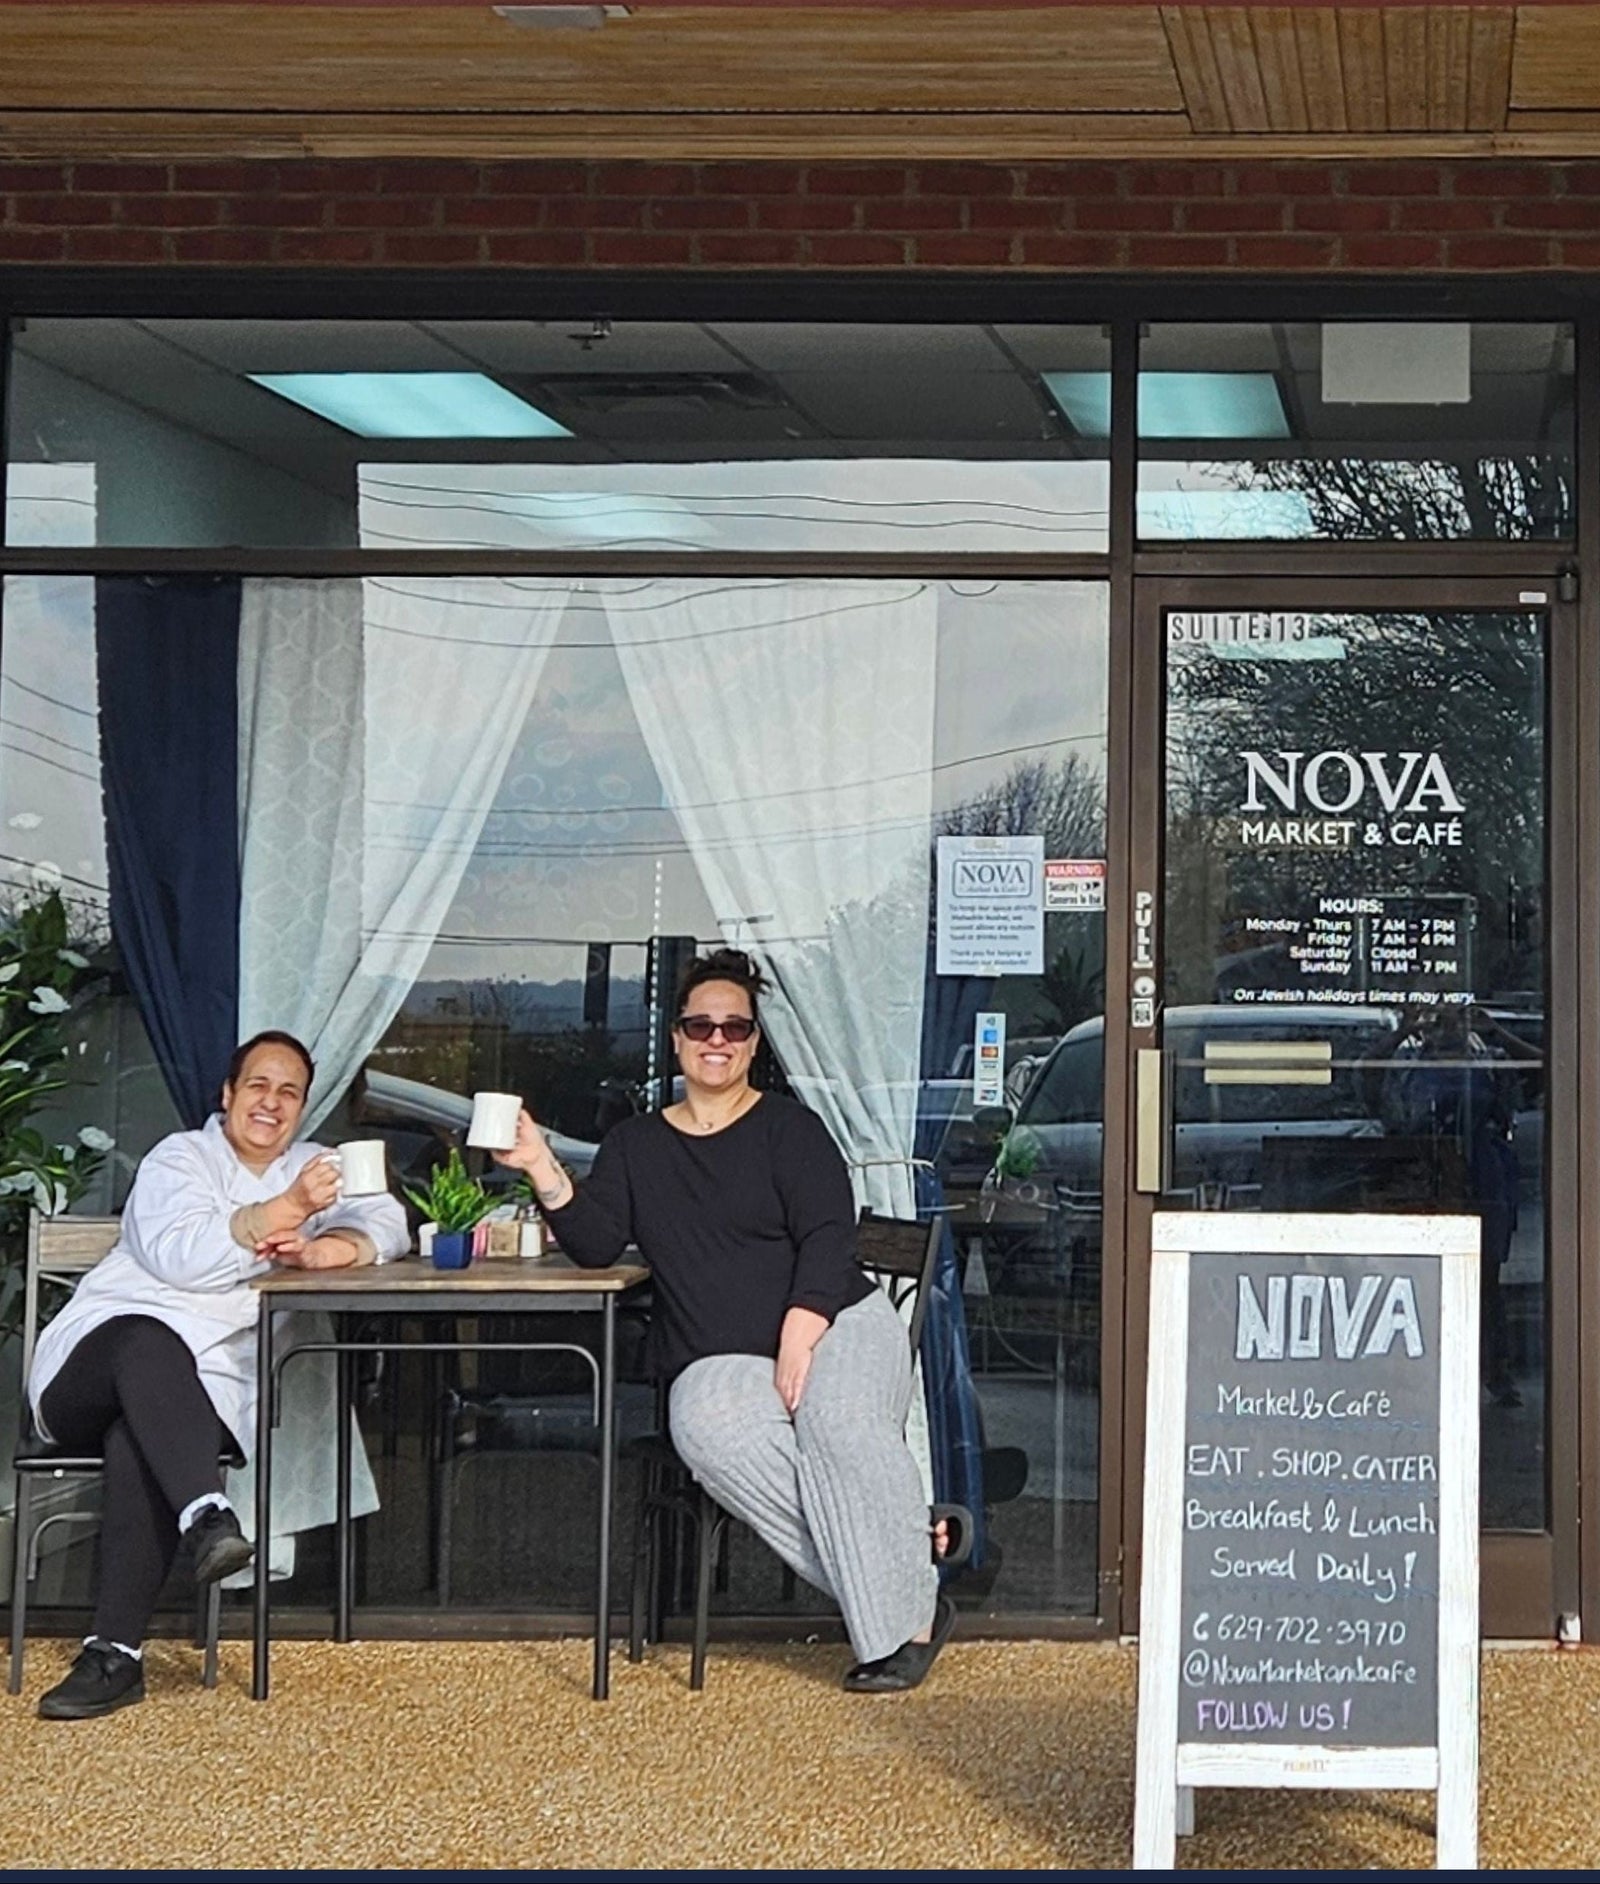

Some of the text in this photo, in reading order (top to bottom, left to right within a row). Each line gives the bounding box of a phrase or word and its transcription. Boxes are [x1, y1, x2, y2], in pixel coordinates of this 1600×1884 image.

[1171, 615, 1305, 642] SUITE 13
[1238, 751, 1467, 813] NOVA
[1241, 816, 1463, 846] MARKET & CAFÉ
[960, 863, 1026, 885] NOVA
[1047, 864, 1103, 876] WARNING
[1049, 881, 1078, 893] Security
[1318, 897, 1386, 914] HOURS:
[1134, 890, 1153, 963] PULL
[1245, 917, 1301, 933] Monday
[1312, 917, 1353, 932] Thurs
[1370, 918, 1380, 932] 7
[1382, 918, 1406, 932] AM
[1421, 918, 1431, 932] 7
[1433, 918, 1457, 932] PM
[1289, 946, 1418, 961] Saturday Closed
[1307, 932, 1352, 948] Friday
[1370, 933, 1380, 946] 7
[1382, 933, 1406, 946] AM
[1420, 933, 1431, 946] 4
[1433, 933, 1457, 946] PM
[1300, 960, 1352, 975] Sunday
[1370, 961, 1382, 973] 11
[1384, 961, 1409, 974] AM
[1422, 961, 1433, 974] 7
[1434, 961, 1458, 974] PM
[1234, 987, 1476, 1005] On Jewish holidays times may vary.
[1236, 1274, 1425, 1361] NOVA
[1326, 1390, 1391, 1418] Café
[1187, 1444, 1250, 1478] EAT
[1352, 1454, 1437, 1482] CATER
[1186, 1498, 1437, 1538] Breakfast & Lunch
[1210, 1547, 1298, 1581] Served
[1197, 1699, 1289, 1732] FOLLOW
